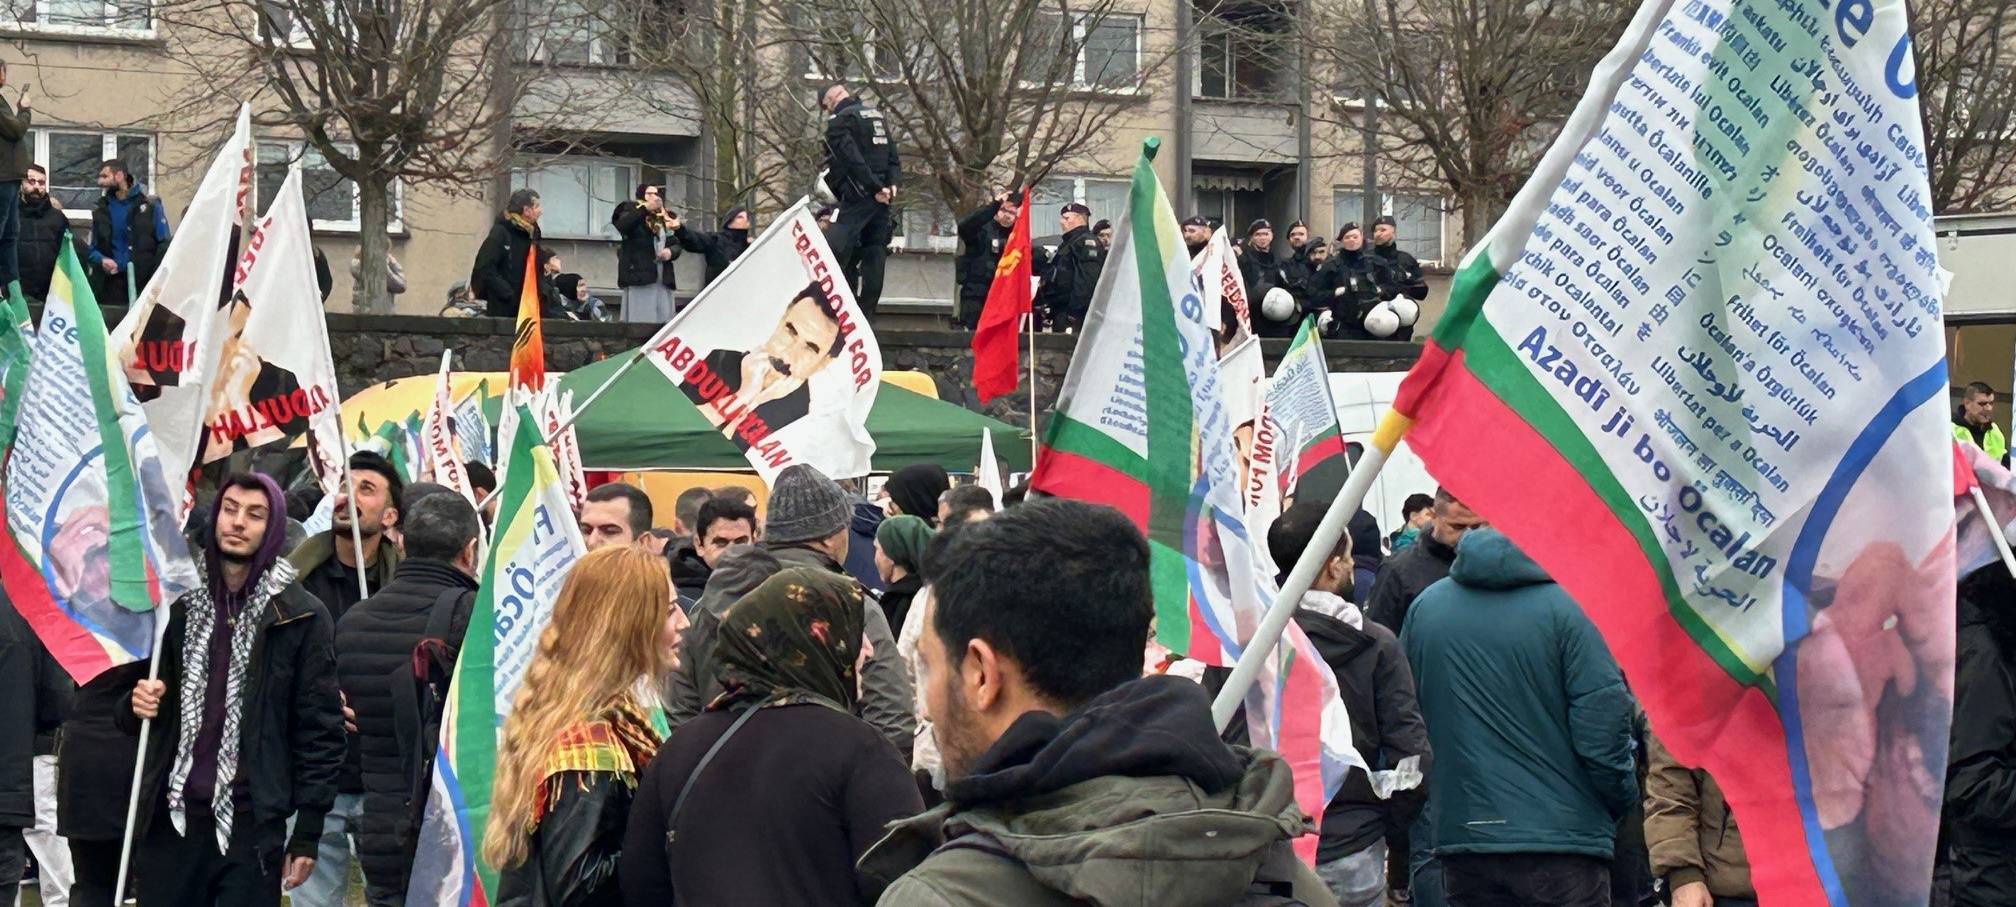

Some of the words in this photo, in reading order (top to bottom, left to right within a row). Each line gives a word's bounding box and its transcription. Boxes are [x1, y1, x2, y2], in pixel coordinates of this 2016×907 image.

[1640, 168, 1684, 215] Ocalan
[1576, 191, 1612, 222] para
[1613, 215, 1657, 265] Öcalan
[1629, 196, 1674, 245] Öcalan
[1550, 237, 1584, 268] para
[1586, 259, 1630, 309] Öcalan
[1607, 244, 1650, 296] Öcalan
[849, 338, 871, 393] FOR
[1790, 349, 1836, 400] Öcalan
[1601, 406, 1635, 438] ji
[1633, 433, 1670, 482] bo
[1679, 480, 1777, 579] Öcalan
